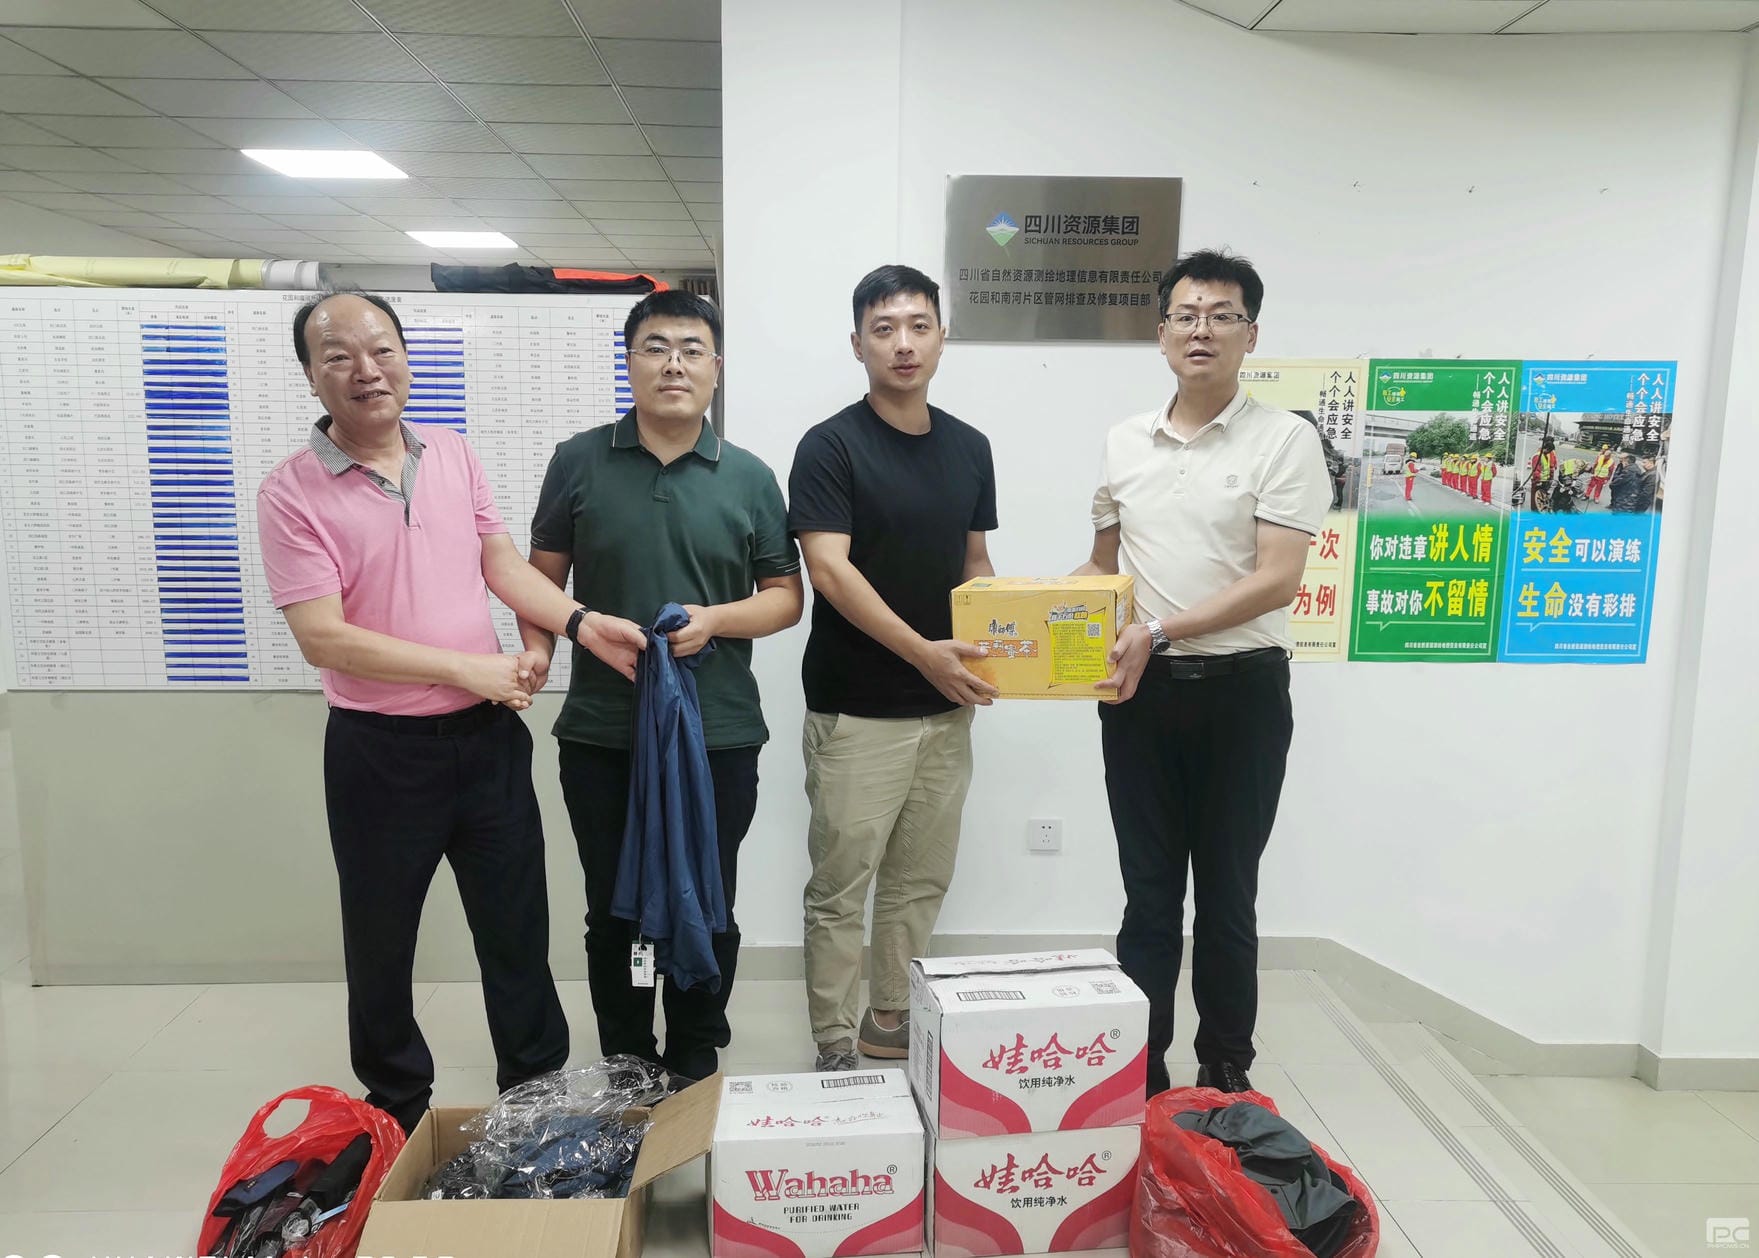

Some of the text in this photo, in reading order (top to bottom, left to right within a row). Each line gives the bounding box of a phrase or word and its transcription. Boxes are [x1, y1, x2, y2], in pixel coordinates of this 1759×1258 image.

[1024, 214, 1140, 236] 四川资源集团
[1024, 237, 1139, 246] SICHUAN RESOURCES GROUP
[959, 267, 1162, 285] 四川省自然资源测绘地理信息有限责任公司
[969, 291, 1151, 307] 花园和南河片区管网排查及修复项目部
[1327, 371, 1341, 440] 个个会应急
[1341, 371, 1356, 440] 人人讲安全
[1479, 371, 1496, 441] 个个会应急
[1494, 371, 1510, 441] 人人讲安全
[1632, 373, 1650, 442] 个个会应急
[1646, 373, 1664, 442] 人人讲安全
[1370, 523, 1494, 563] 你对违章讲人情
[1523, 526, 1642, 564] 安全可以演练
[1293, 584, 1337, 617] 为例
[1365, 578, 1489, 618] 事故对你不留情
[1517, 581, 1637, 619] 生命没有彩排
[982, 1032, 1116, 1075] 娃哈哈
[1018, 1075, 1076, 1089] 饮用纯净水
[745, 1168, 895, 1202] Wahaha
[973, 1152, 1107, 1194] 娃哈哈
[783, 1202, 860, 1215] PURIFIED WATER
[790, 1214, 808, 1224] FOR
[812, 1212, 853, 1223] DRINKING
[1010, 1195, 1068, 1209] 饮用纯净水
